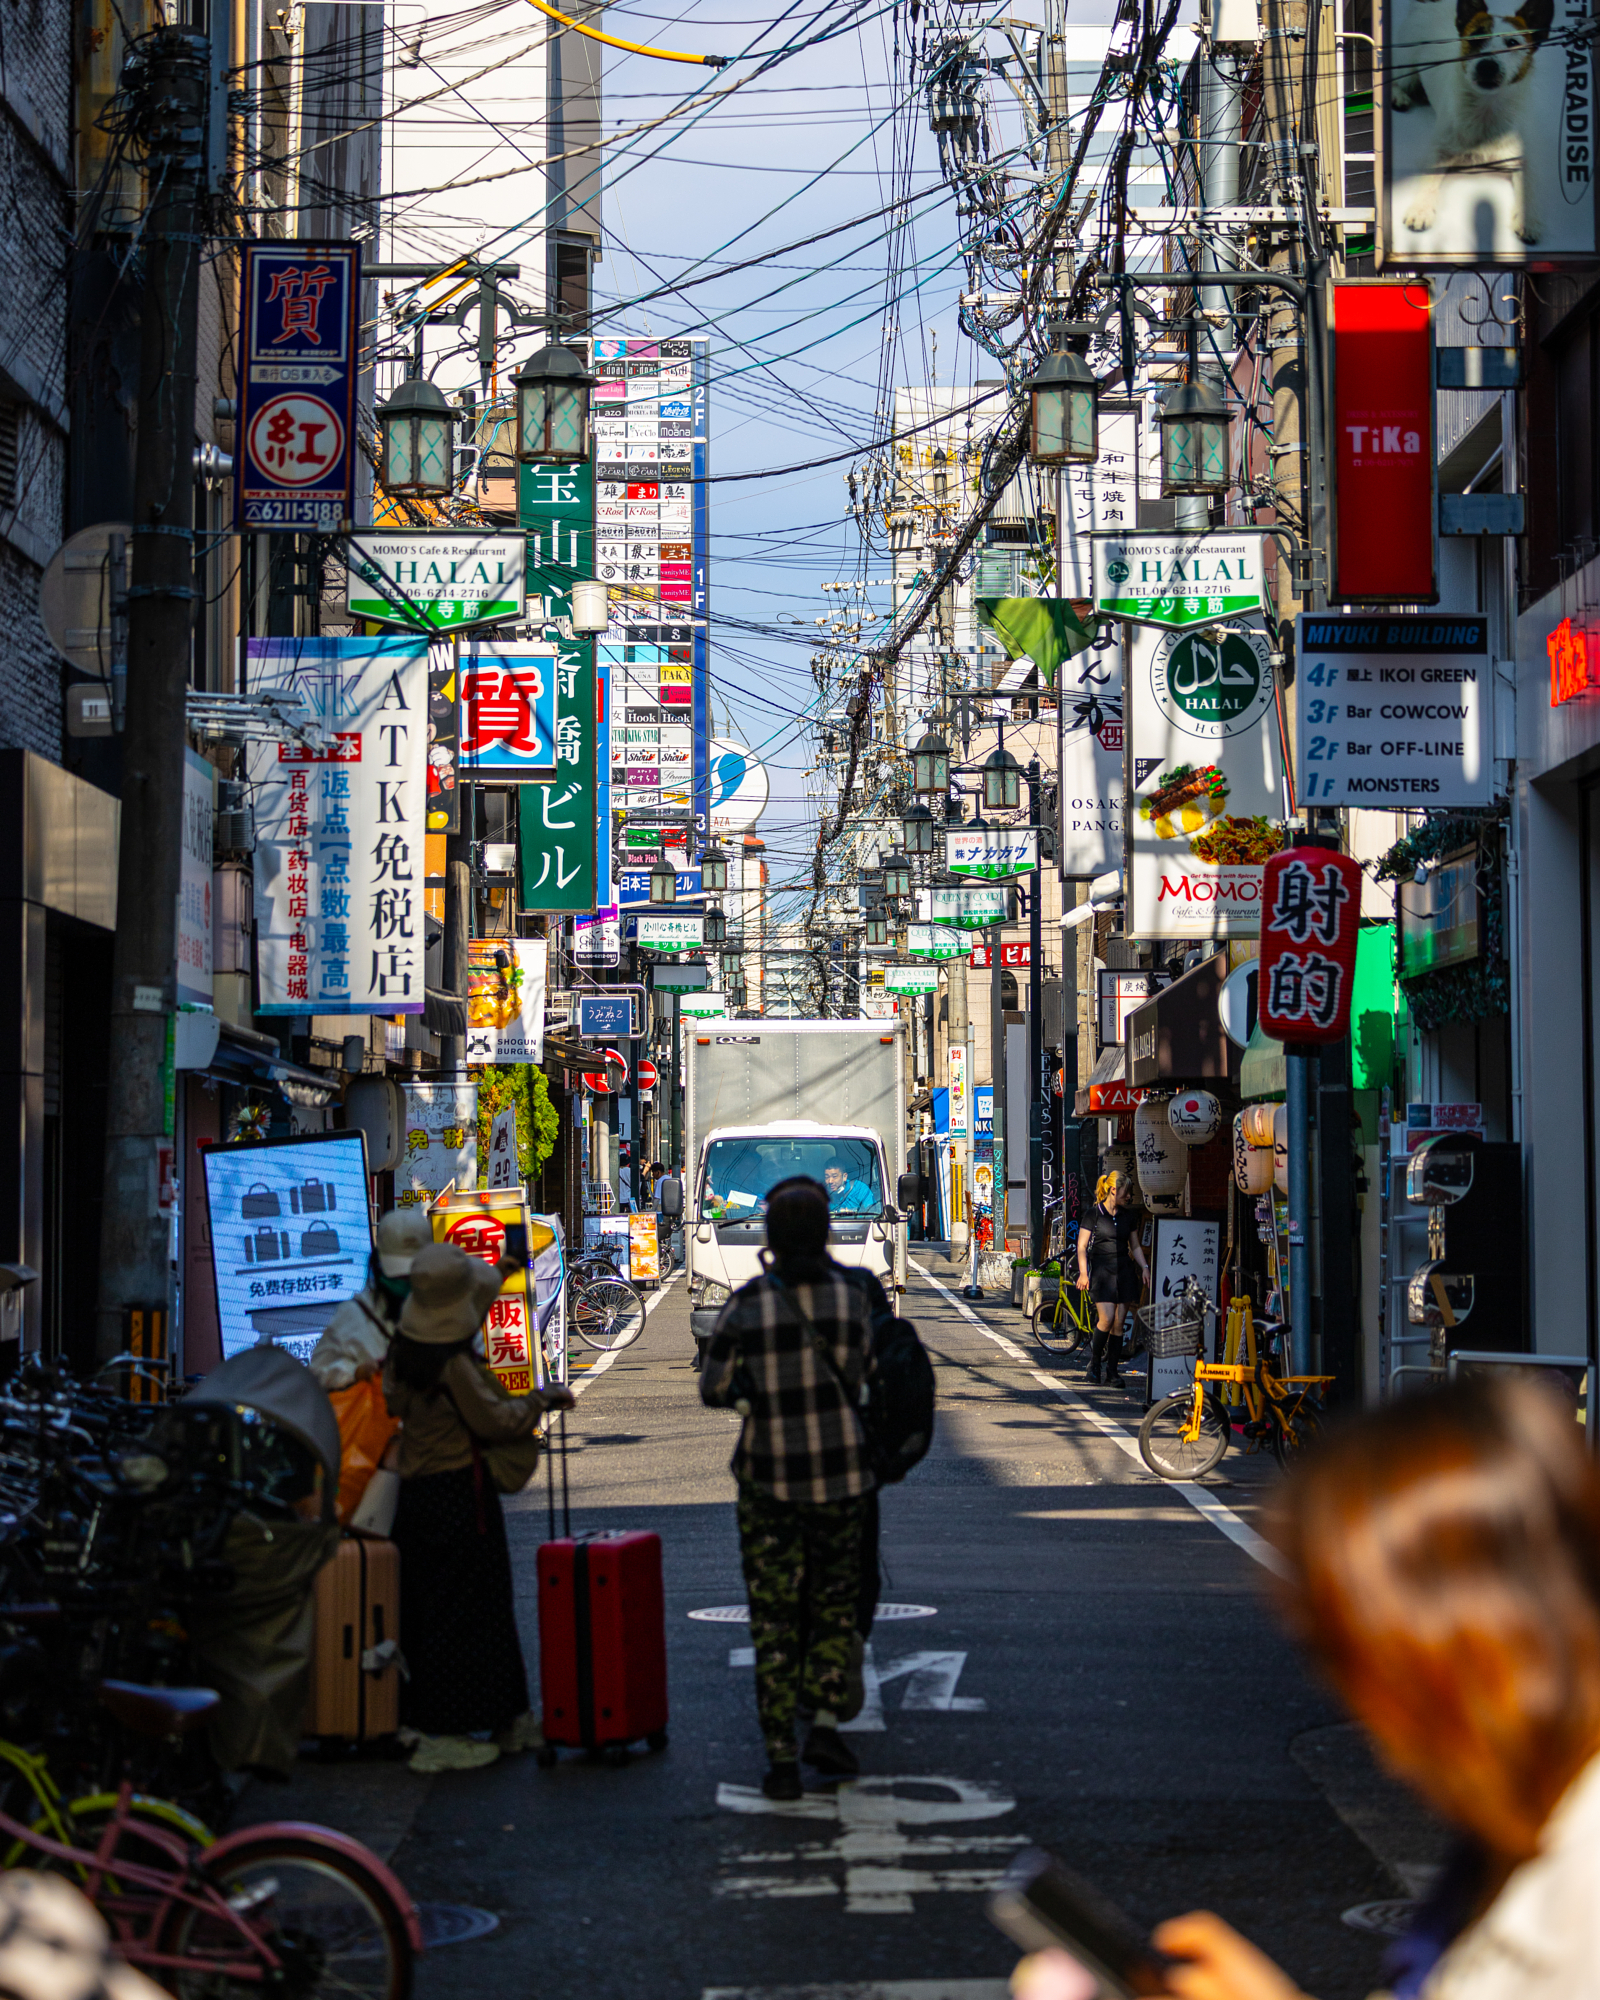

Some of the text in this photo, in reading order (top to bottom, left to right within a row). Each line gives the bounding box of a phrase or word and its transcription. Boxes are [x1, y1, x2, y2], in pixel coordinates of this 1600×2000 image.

[265, 266, 337, 345] 質
[259, 349, 338, 357] PAWN SHOP
[266, 408, 327, 468] 紅
[660, 427, 690, 437] Moana
[1346, 426, 1420, 453] TiKa
[661, 465, 691, 474] LEGEND
[604, 484, 618, 498] 雄
[637, 486, 657, 498] まり
[1101, 453, 1126, 522] 和牛焼肉
[246, 491, 343, 500] MARUBENI
[419, 546, 441, 556] Cafe
[442, 546, 449, 555] &
[451, 546, 506, 556] Restaurant
[1162, 547, 1184, 555] Cafe
[1185, 547, 1194, 555] &
[1193, 546, 1246, 555] Restaurant
[395, 561, 514, 585] HALAL
[1140, 559, 1254, 583] HALAL
[407, 588, 489, 598] 06-6214-2716
[1152, 585, 1231, 596] 06-6214-2716
[1137, 597, 1224, 616] 三ツ寺筋
[1307, 625, 1480, 645] MIYUKI BUILDING
[662, 671, 690, 680] TAKA
[1307, 663, 1339, 687] 4F
[1380, 669, 1415, 683] IKOI
[1421, 669, 1477, 683] GREEN
[1185, 698, 1243, 710] HALAL
[460, 668, 541, 755] 質
[628, 714, 656, 723] Hook
[662, 714, 691, 723] Hook
[1307, 699, 1469, 724] 3F Bar COWCOW
[1195, 723, 1233, 735] HCA
[1307, 736, 1465, 760] 2F Bar OFF-LINE
[1137, 760, 1148, 769] 3F
[1137, 769, 1148, 778] 2F
[1307, 773, 1440, 797] 1F MONSTERS
[367, 668, 414, 997] ATK免税店
[955, 836, 983, 844] 世界の酒
[627, 854, 643, 864] Black
[644, 854, 658, 864] Pink
[969, 864, 1016, 875] 三ツ寺筋
[1171, 905, 1194, 919] Cafe
[1206, 904, 1260, 916] Restaurant
[1268, 862, 1348, 1027] 射的
[973, 946, 1031, 966] 喜ビル
[1108, 976, 1116, 1028] Sumi Yakitori
[497, 1038, 537, 1046] SHOGUN
[497, 1047, 537, 1056] BURGER
[416, 1109, 455, 1127] bag
[408, 1128, 465, 1150] 免税
[403, 1190, 437, 1203] DUTY
[1170, 1233, 1189, 1267] 大阪
[1203, 1228, 1216, 1265] 和牛焼肉
[250, 1272, 344, 1298] 免费存放行李
